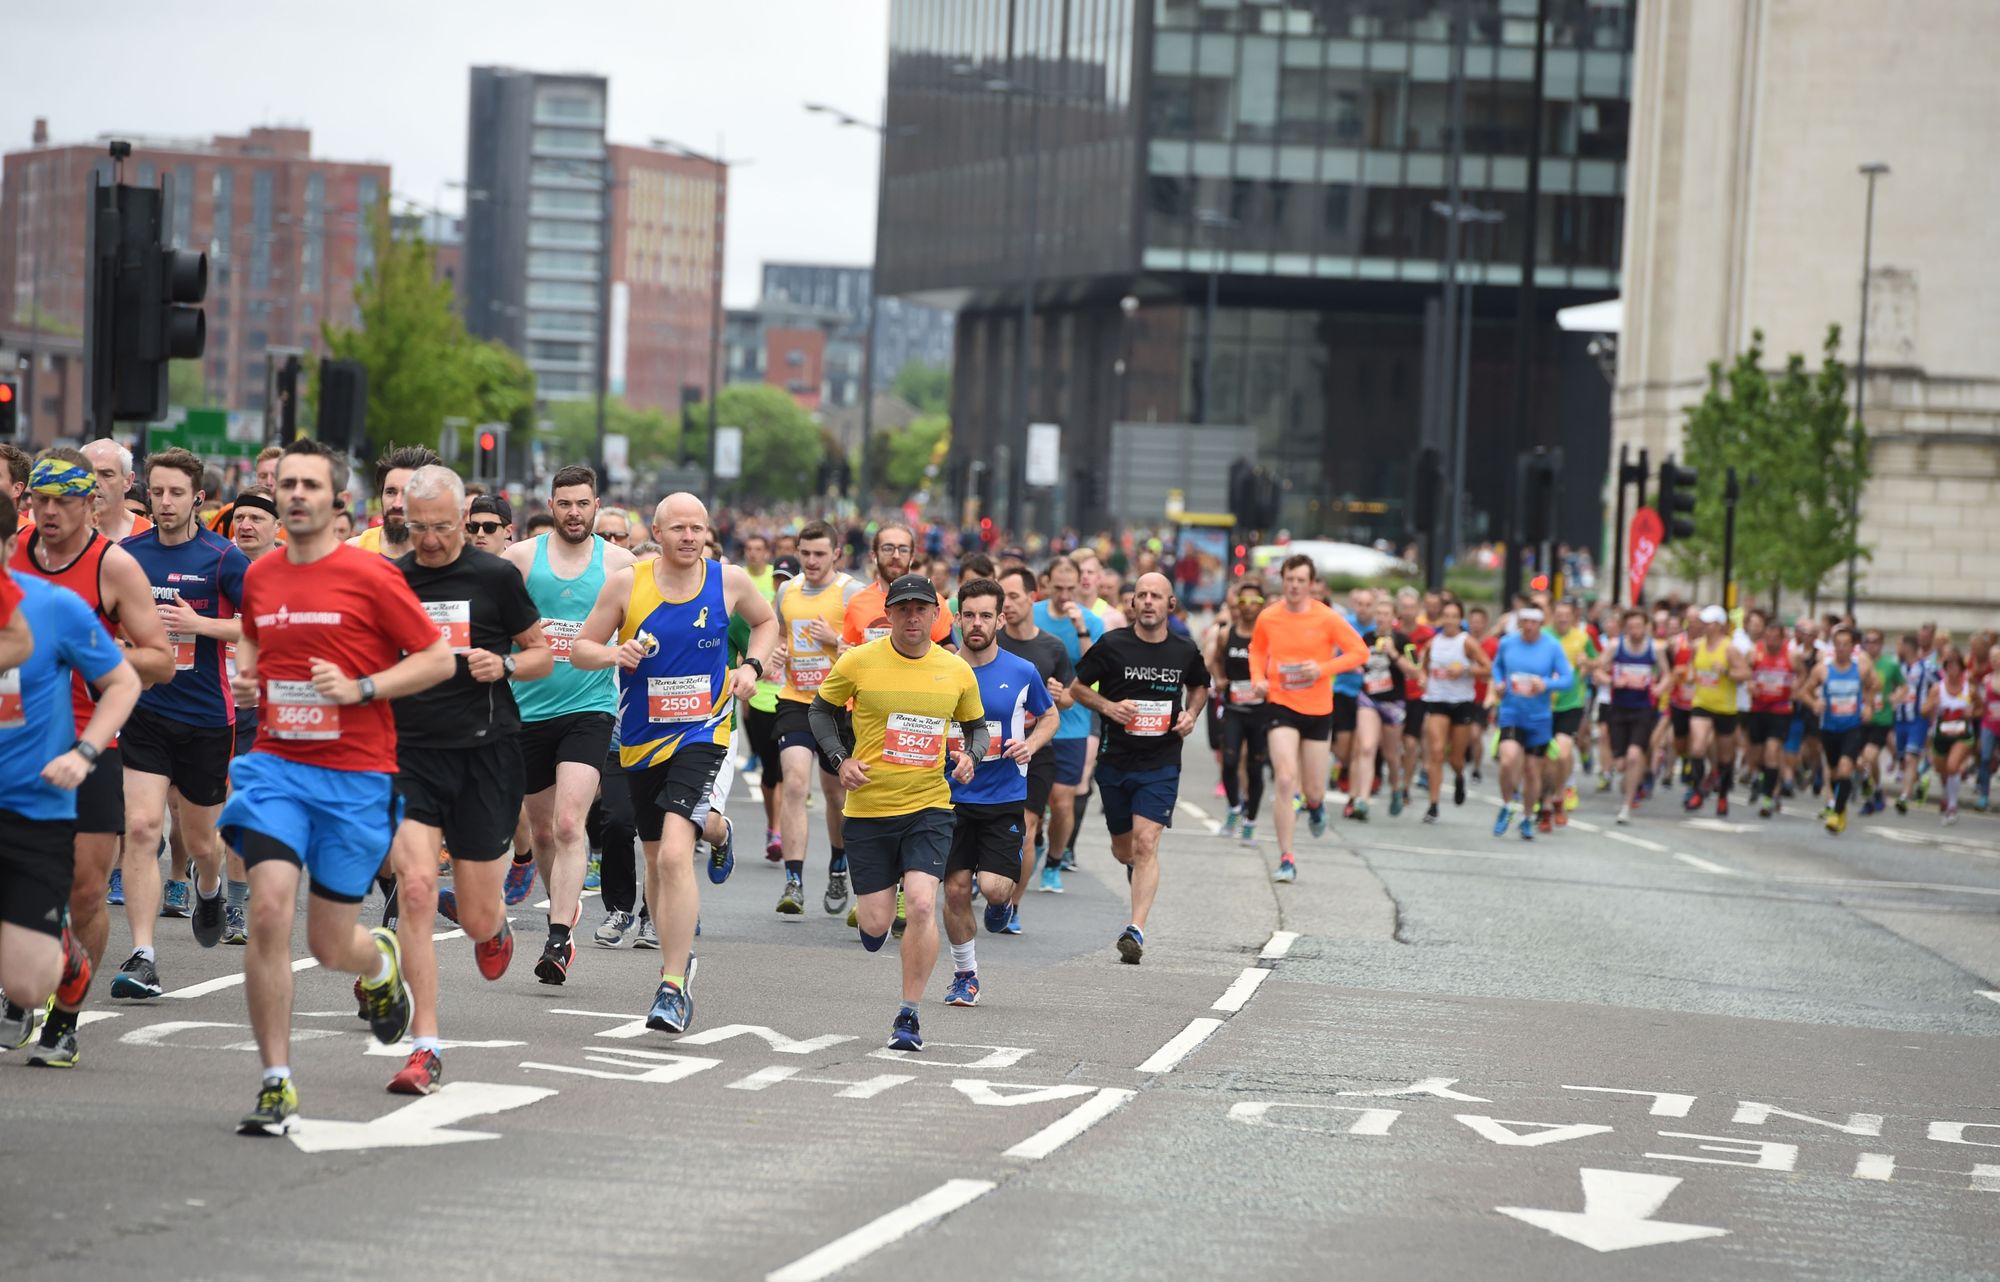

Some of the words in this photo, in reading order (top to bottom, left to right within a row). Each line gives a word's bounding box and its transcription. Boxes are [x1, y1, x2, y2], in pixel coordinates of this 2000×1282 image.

[554, 626, 580, 634] LIVERPO
[697, 638, 721, 649] Colin
[796, 670, 822, 682] 2920
[1124, 666, 1183, 683] PARIS-EST
[660, 696, 700, 711] 2590
[276, 706, 324, 725] 3660
[895, 713, 918, 722] Rock
[926, 717, 942, 725] Roll
[1134, 716, 1163, 727] 2824
[903, 721, 933, 730] LIVERPOOL
[897, 733, 933, 749] 5647
[1228, 1101, 2000, 1193] HEAD
